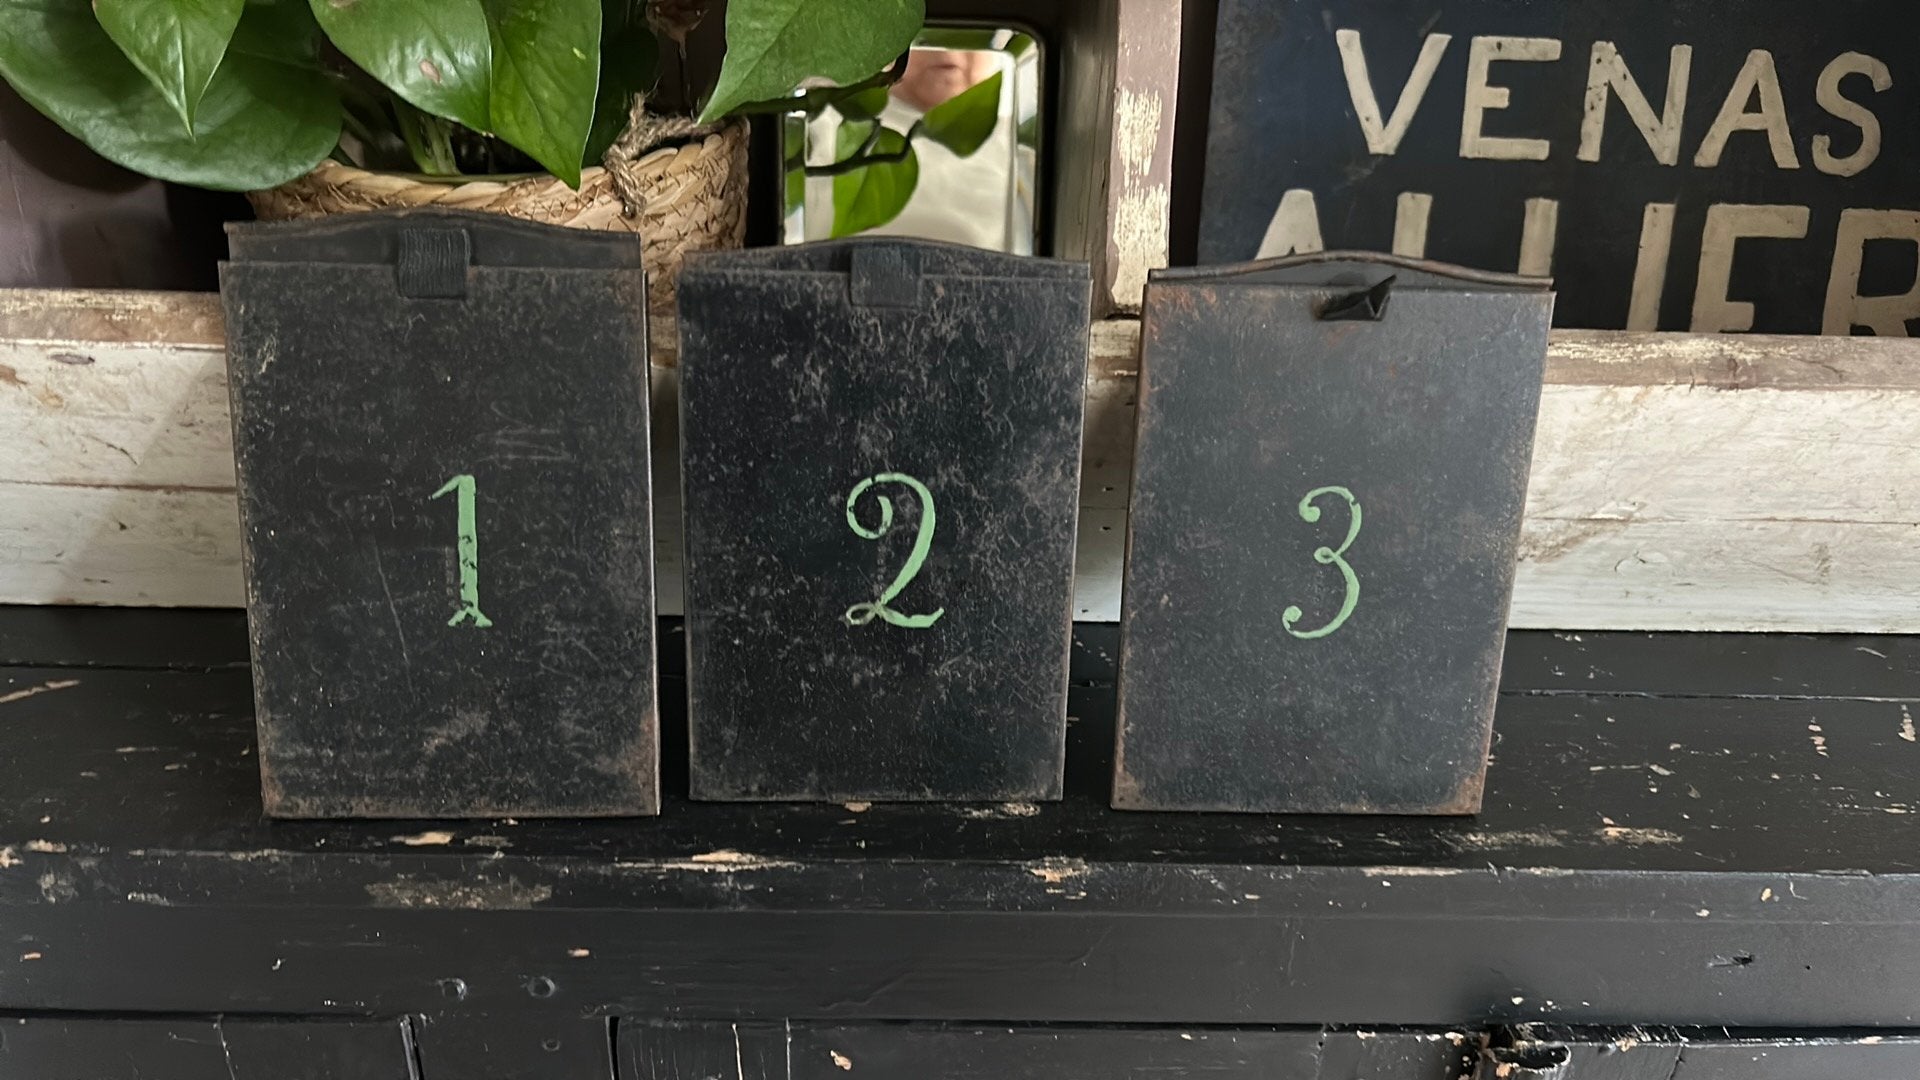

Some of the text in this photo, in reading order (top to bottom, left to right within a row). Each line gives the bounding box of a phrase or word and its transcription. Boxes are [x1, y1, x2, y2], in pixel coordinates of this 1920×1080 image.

[1336, 28, 1893, 178] VENAS
[431, 474, 493, 627] 1
[844, 472, 945, 628] 2
[1281, 485, 1363, 640] 3
